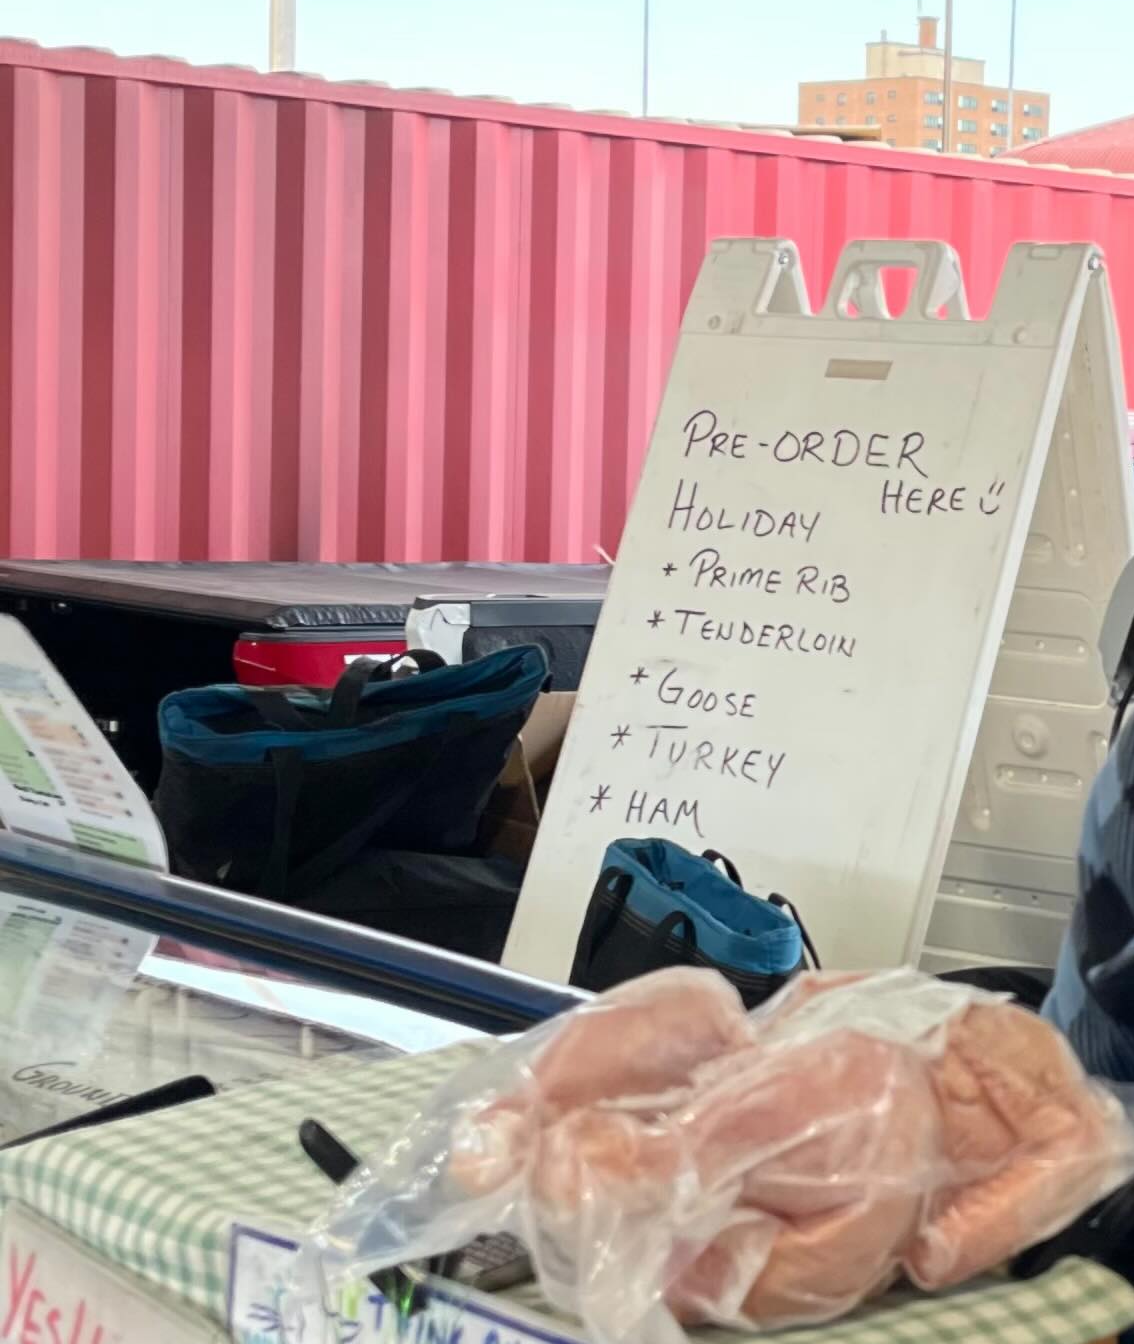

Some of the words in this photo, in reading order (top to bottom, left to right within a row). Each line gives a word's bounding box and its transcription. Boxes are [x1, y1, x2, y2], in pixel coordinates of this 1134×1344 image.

[683, 410, 928, 478] PRE-ORDER
[667, 479, 821, 543] HOLIDAY
[881, 479, 967, 515] HERE
[689, 548, 782, 594] PRIME
[796, 565, 851, 604] RIB
[674, 609, 856, 658] TENDERLOIN
[658, 667, 757, 717] GOOSE
[646, 725, 787, 789] TURKEY
[625, 789, 705, 839] HAM
